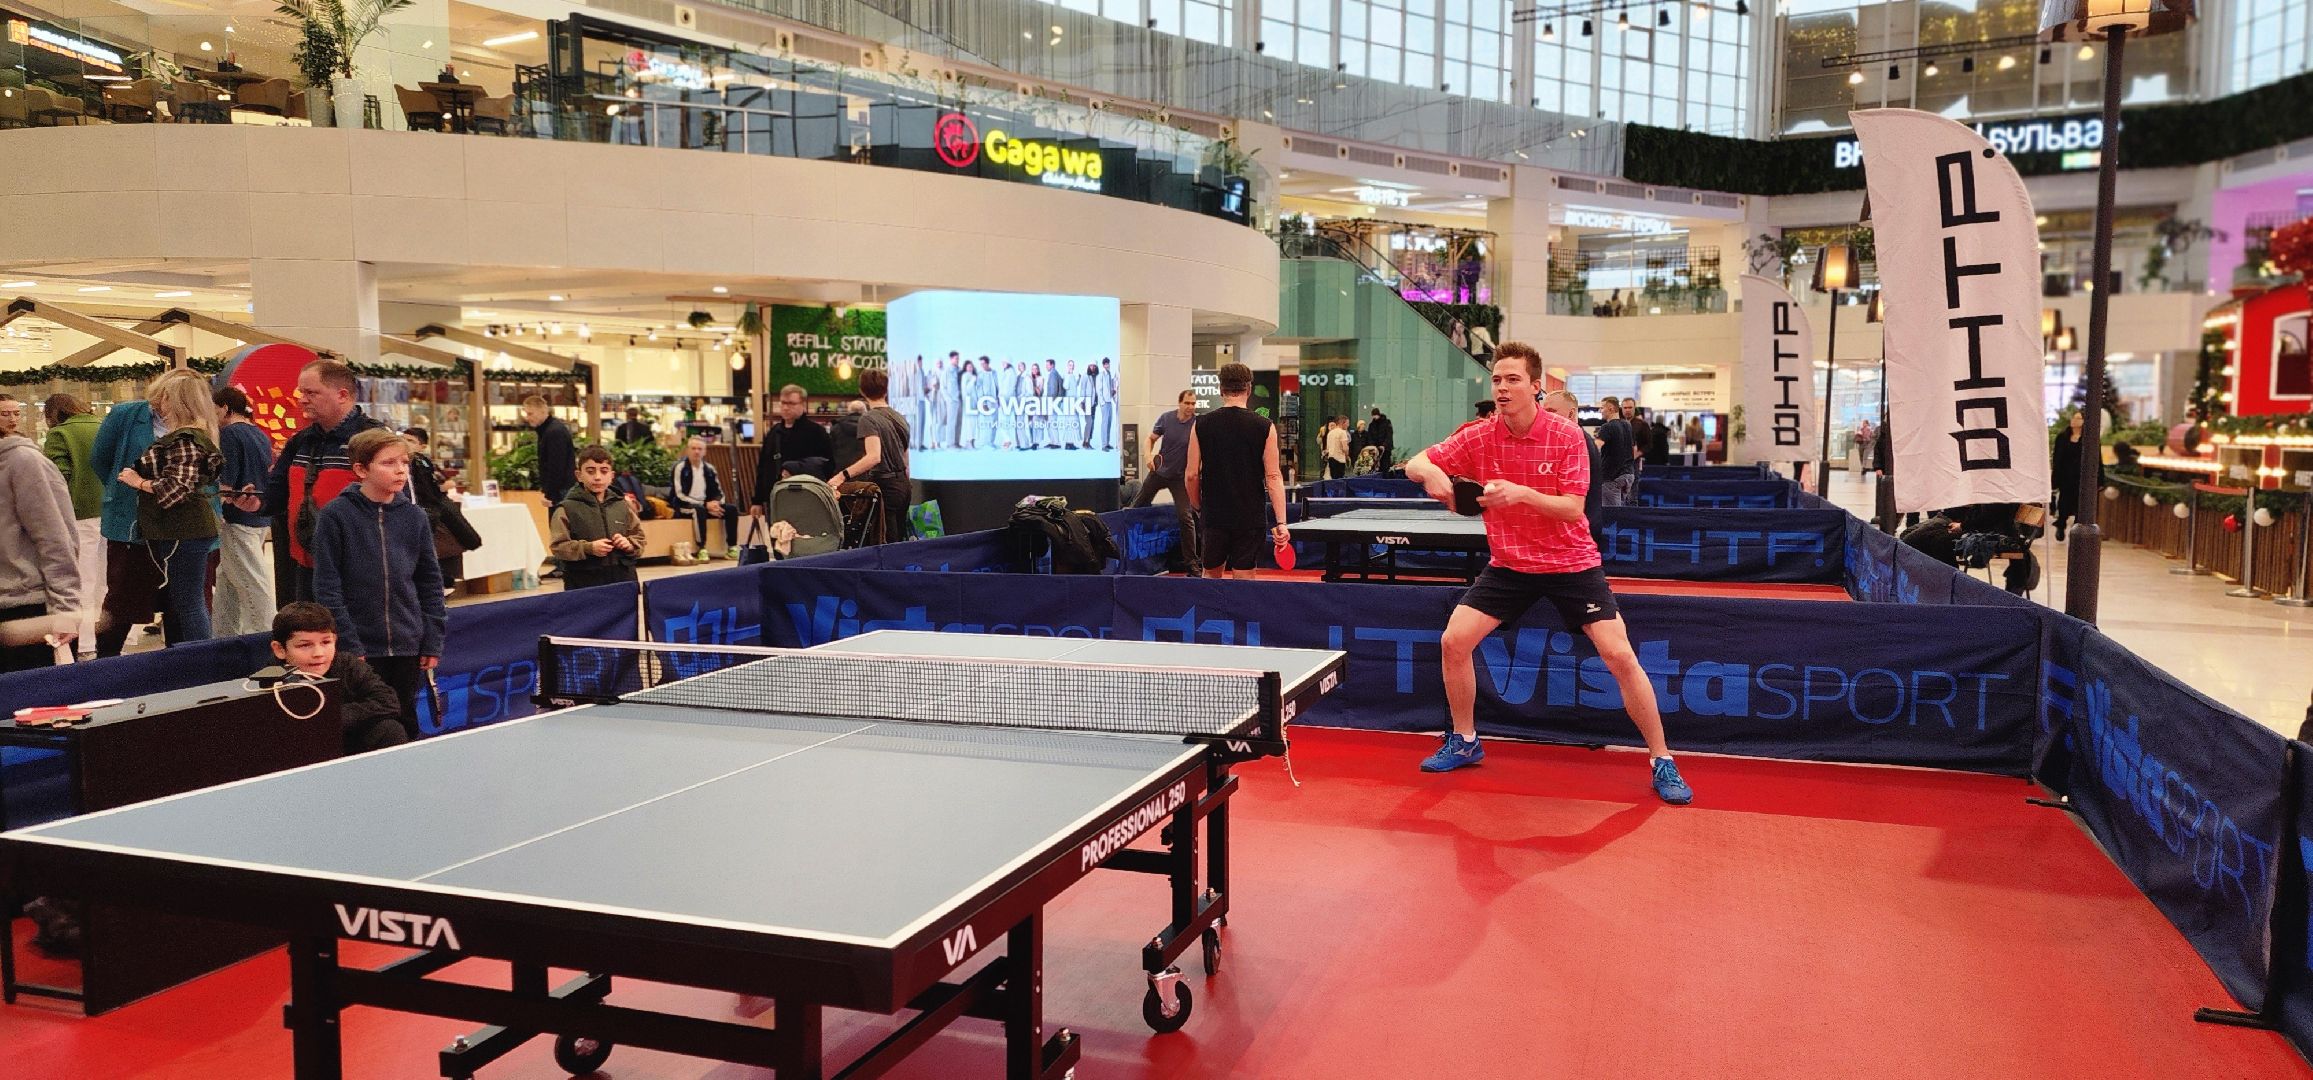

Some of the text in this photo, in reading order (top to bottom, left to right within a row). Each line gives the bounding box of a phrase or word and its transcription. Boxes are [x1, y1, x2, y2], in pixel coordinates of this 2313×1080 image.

[985, 129, 1102, 179] Gagawa
[787, 333, 887, 352] REFILL STATIO
[790, 352, 819, 368] ДЛЯ
[1191, 374, 1220, 384] TATIO
[1191, 386, 1220, 396] ТОТЫ
[965, 395, 997, 416] LC
[1195, 399, 1210, 408] ETIC
[1375, 536, 1410, 545] VISTA
[1319, 671, 1337, 695] VISTA
[1081, 781, 1186, 872] PROFESSIONAL 250
[334, 903, 460, 951] VISTA
